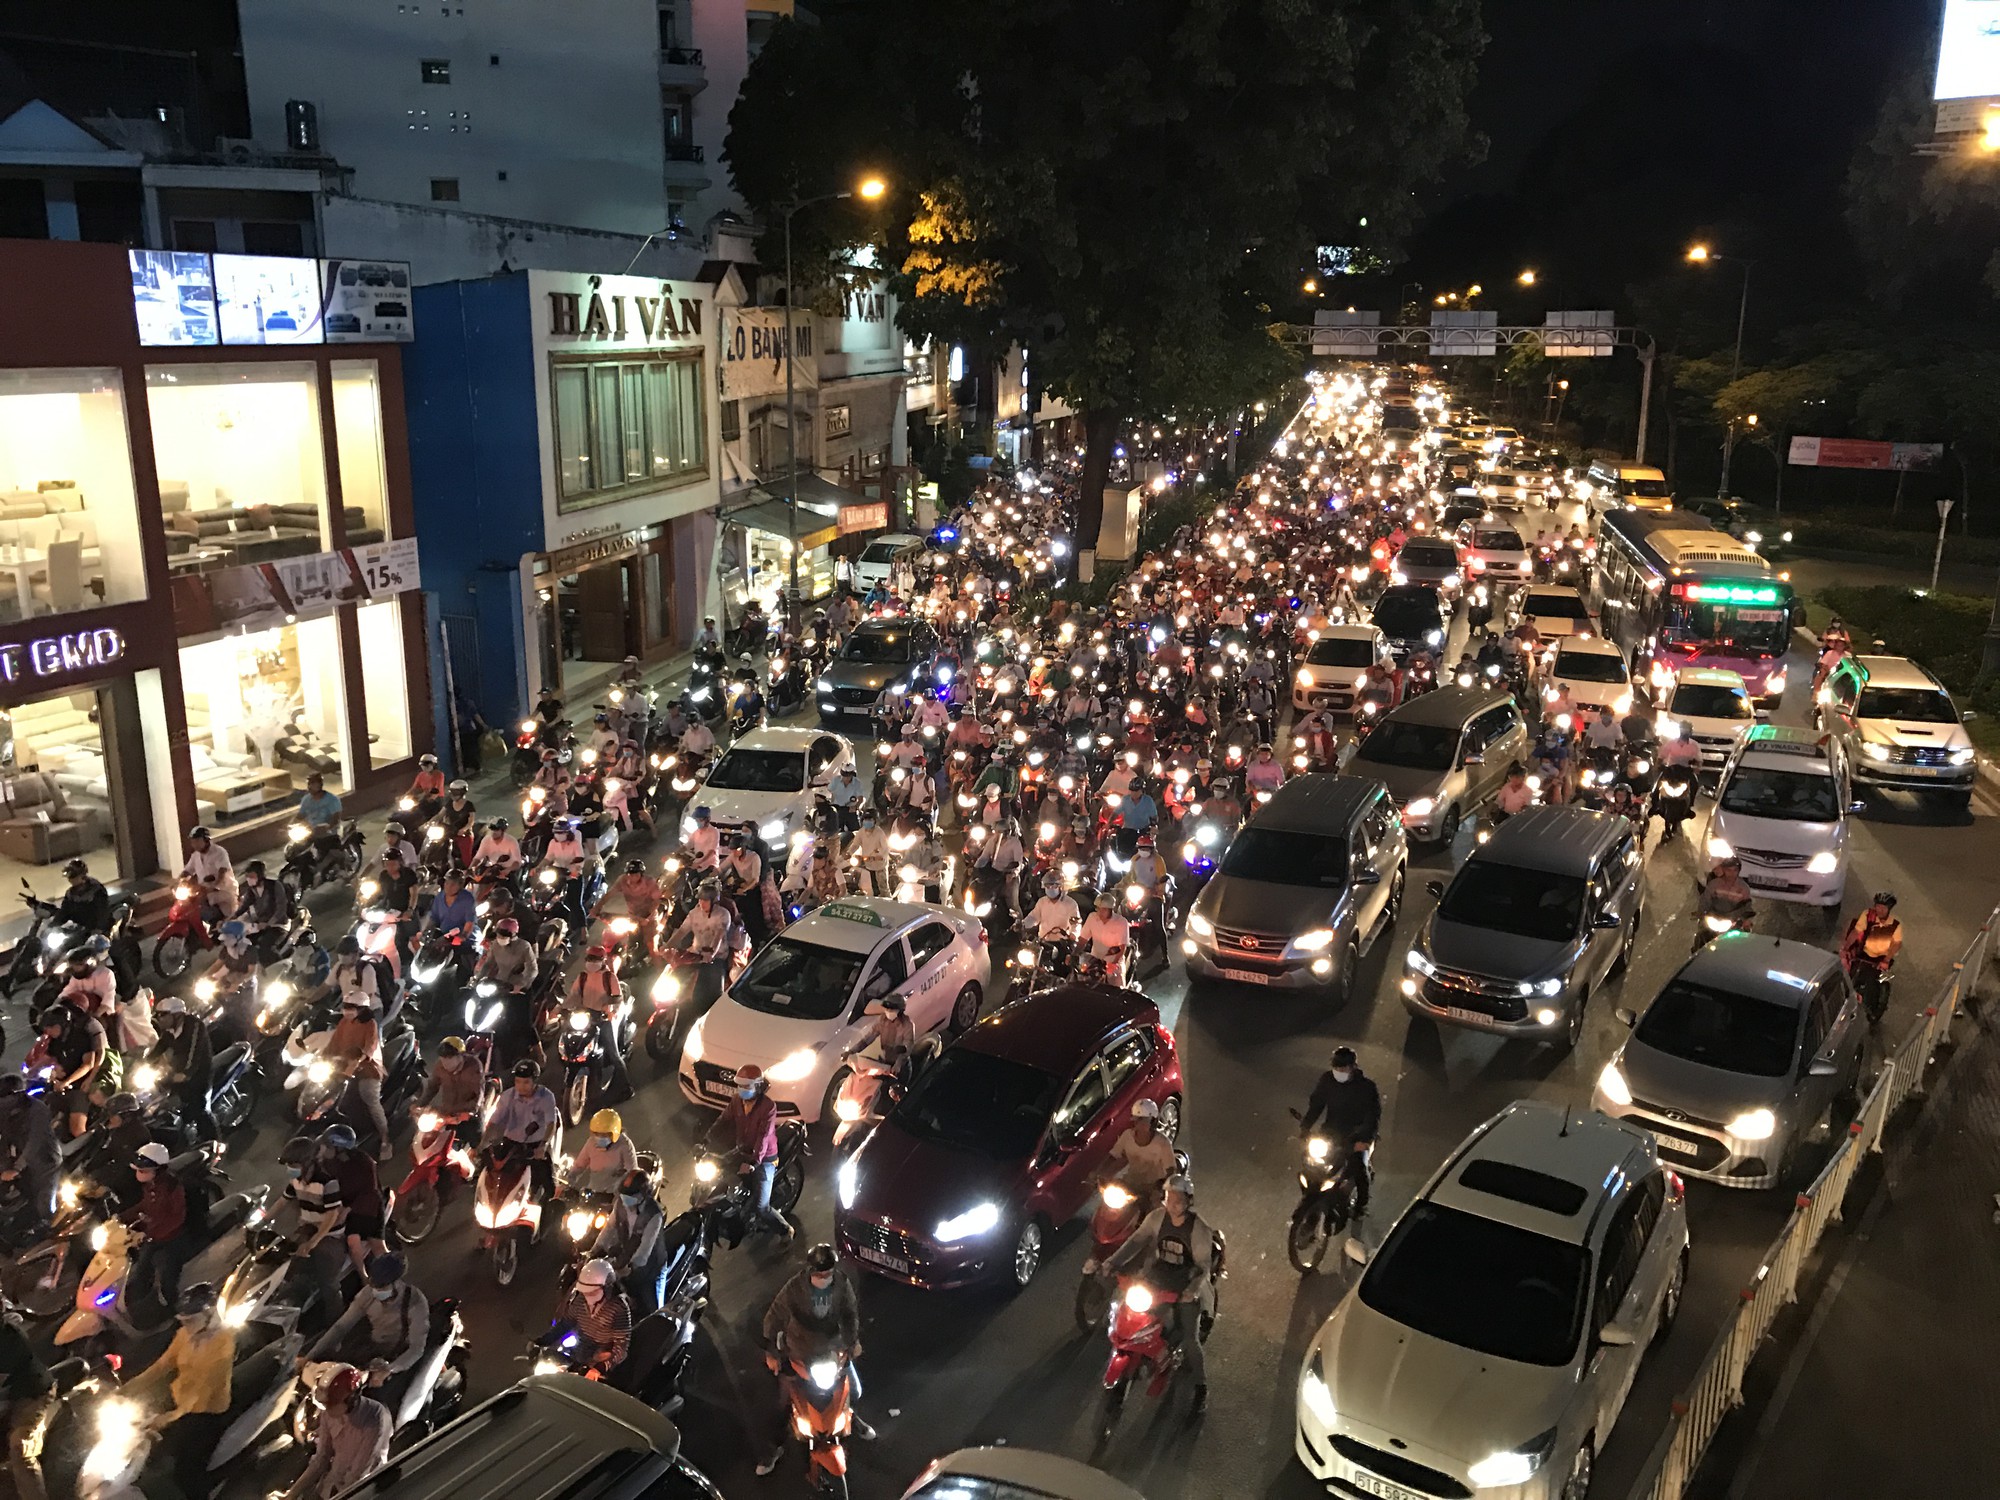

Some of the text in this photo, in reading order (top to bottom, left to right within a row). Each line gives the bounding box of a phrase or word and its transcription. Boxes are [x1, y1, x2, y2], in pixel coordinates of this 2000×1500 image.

[548, 275, 702, 342] HẢI VÂN
[796, 317, 811, 357] MÌ
[367, 565, 402, 590] 15%
